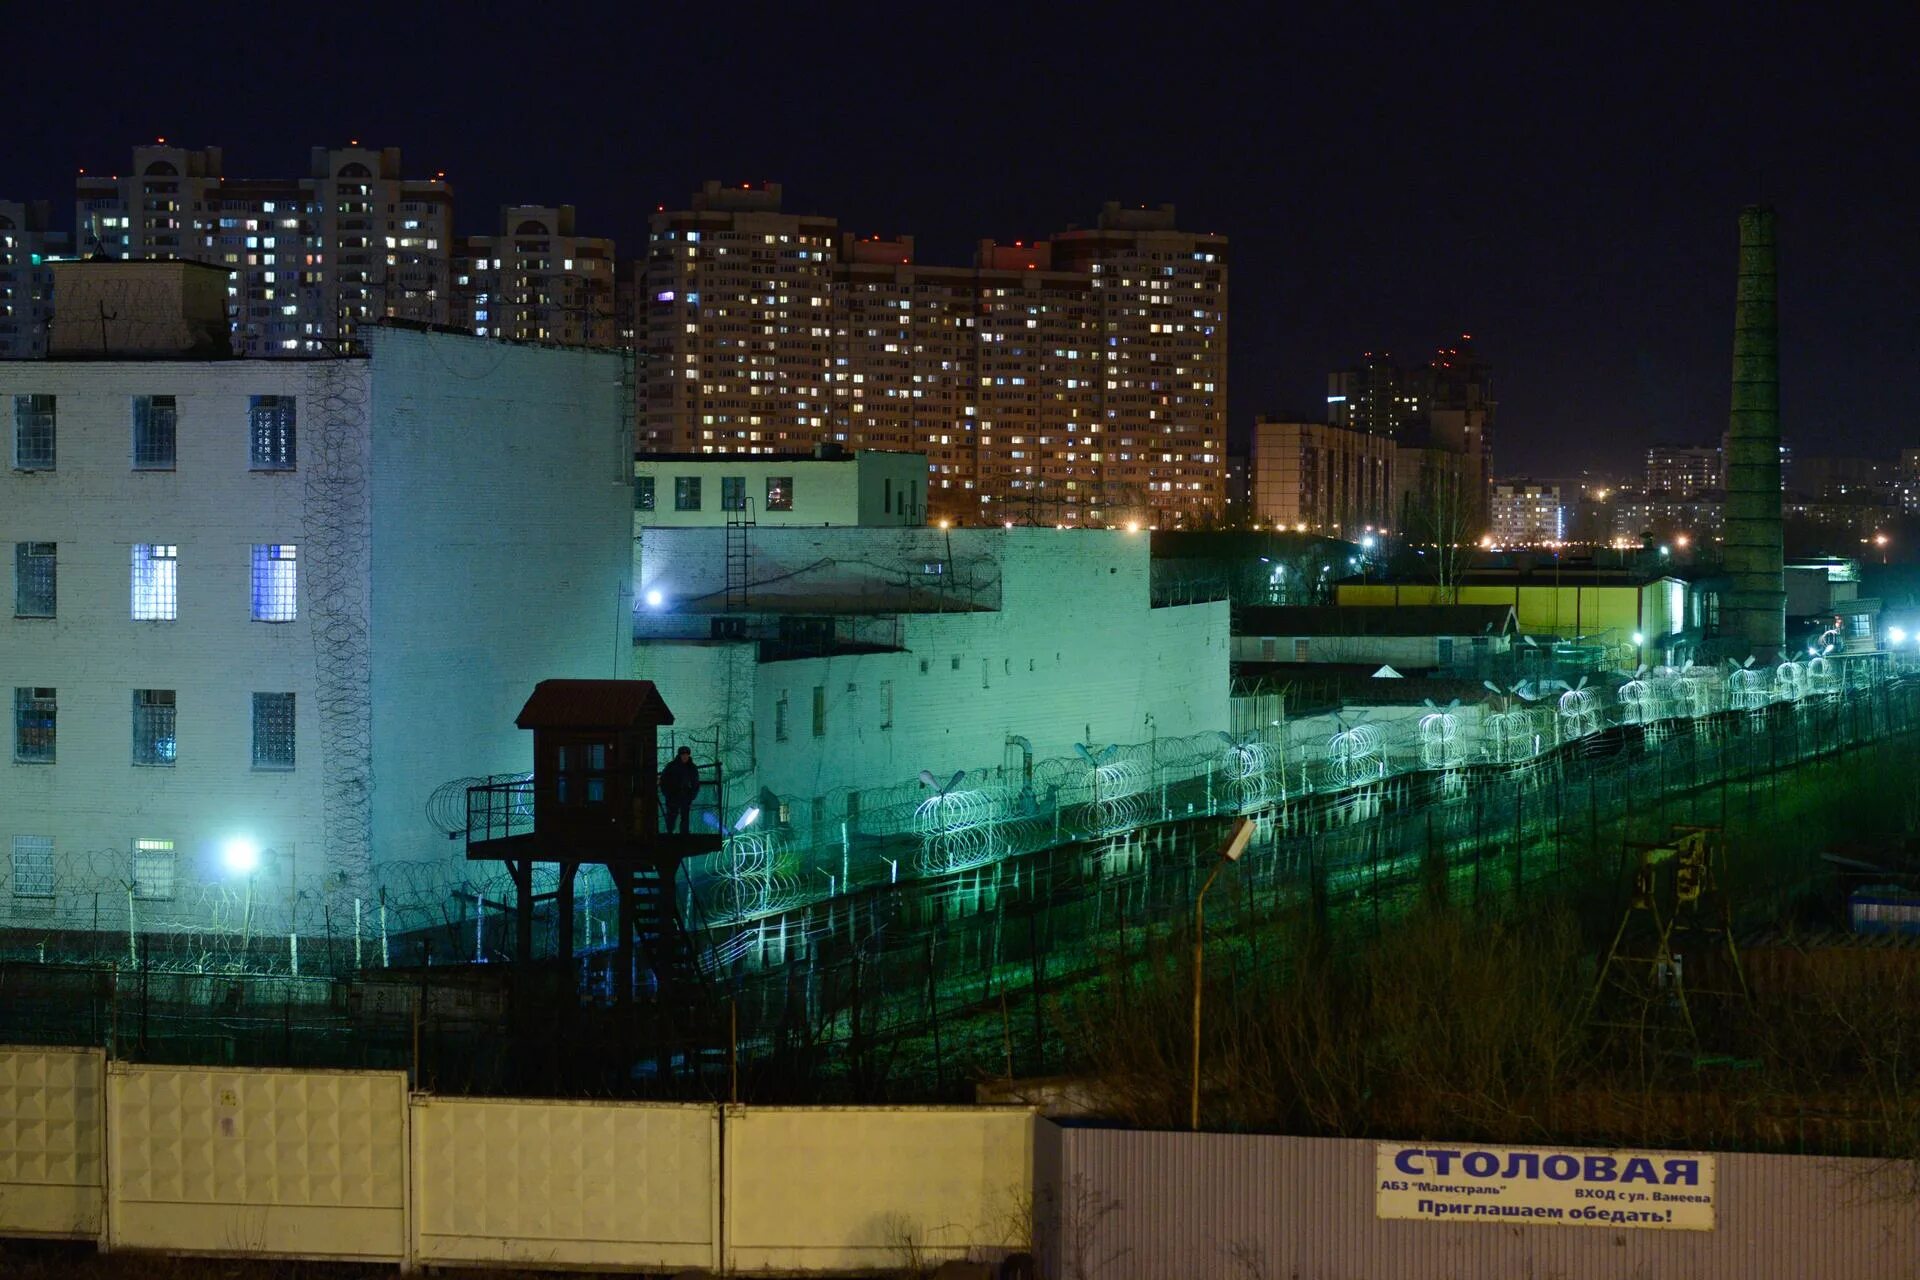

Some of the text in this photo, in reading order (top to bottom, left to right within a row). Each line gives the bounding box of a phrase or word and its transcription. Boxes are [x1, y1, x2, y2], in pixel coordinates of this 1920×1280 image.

[1394, 1149, 1699, 1186] СТОЛОВАЯ
[1381, 1180, 1507, 1196] АБЗ "Магистраль"
[1575, 1188, 1712, 1204] ВХОД с ул. Ванеева
[1417, 1199, 1673, 1224] Приглашаем обедать!
